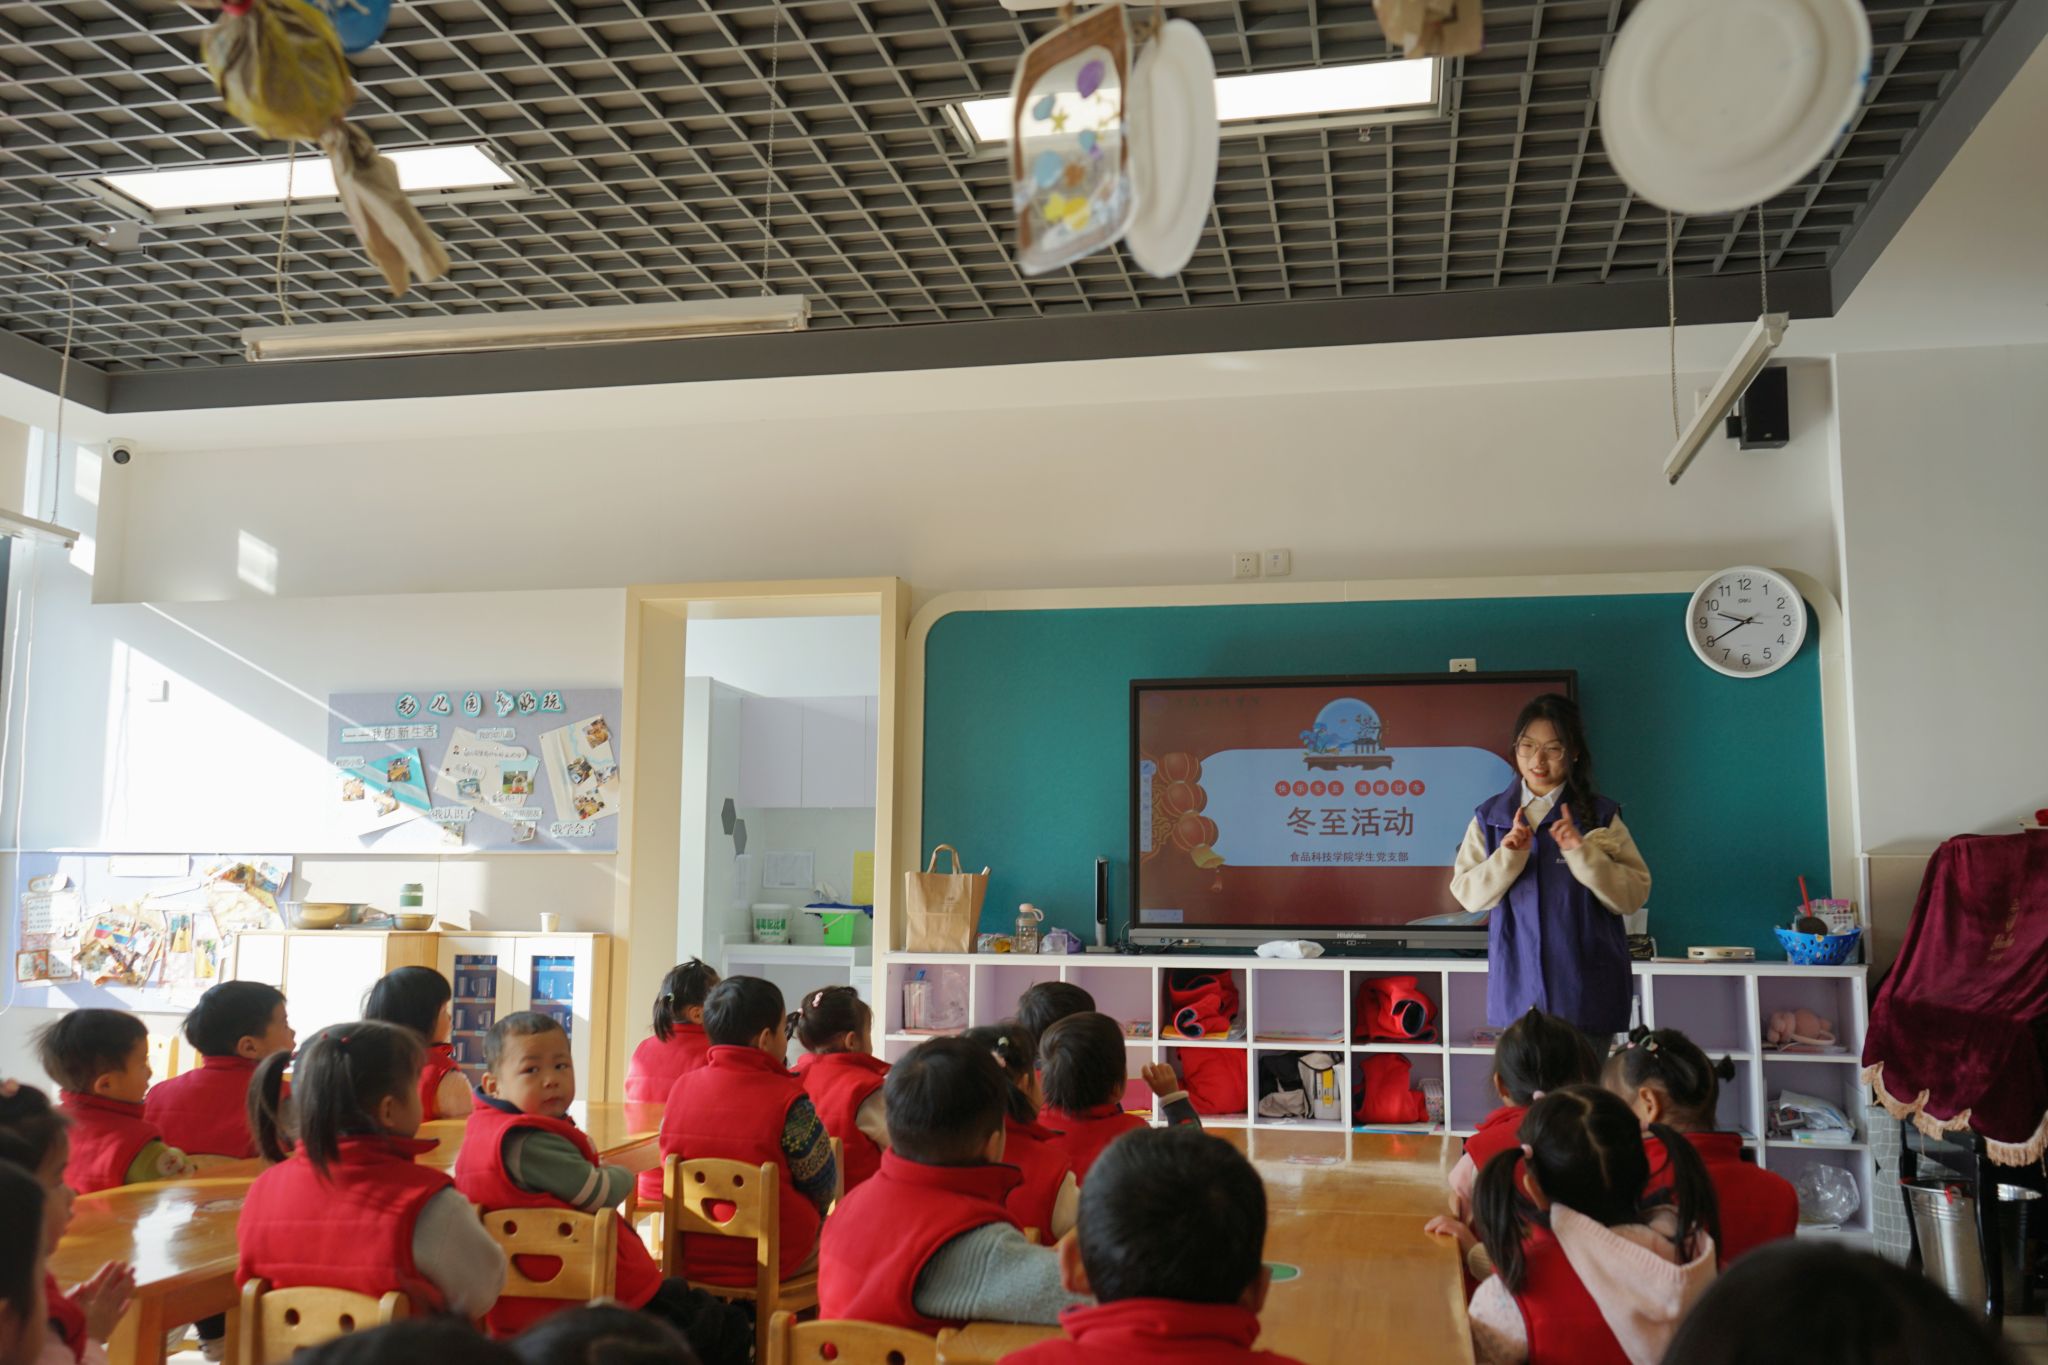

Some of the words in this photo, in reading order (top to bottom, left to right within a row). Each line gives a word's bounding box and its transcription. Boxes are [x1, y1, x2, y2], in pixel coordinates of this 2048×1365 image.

[1719, 585, 1731, 596] 11
[1737, 578, 1752, 591] 12
[1762, 584, 1768, 595] 1
[1705, 599, 1719, 611] 10
[1776, 597, 1785, 609] 2
[1699, 617, 1708, 629] 9
[1782, 614, 1791, 626] 3
[1706, 635, 1715, 647] 8
[1776, 634, 1784, 645] 4
[1722, 648, 1731, 660] 7
[1763, 647, 1771, 659] 5
[1742, 654, 1750, 665] 6
[1286, 806, 1414, 837] 冬至活动
[1290, 851, 1410, 863] 食品科技学院学生党支部
